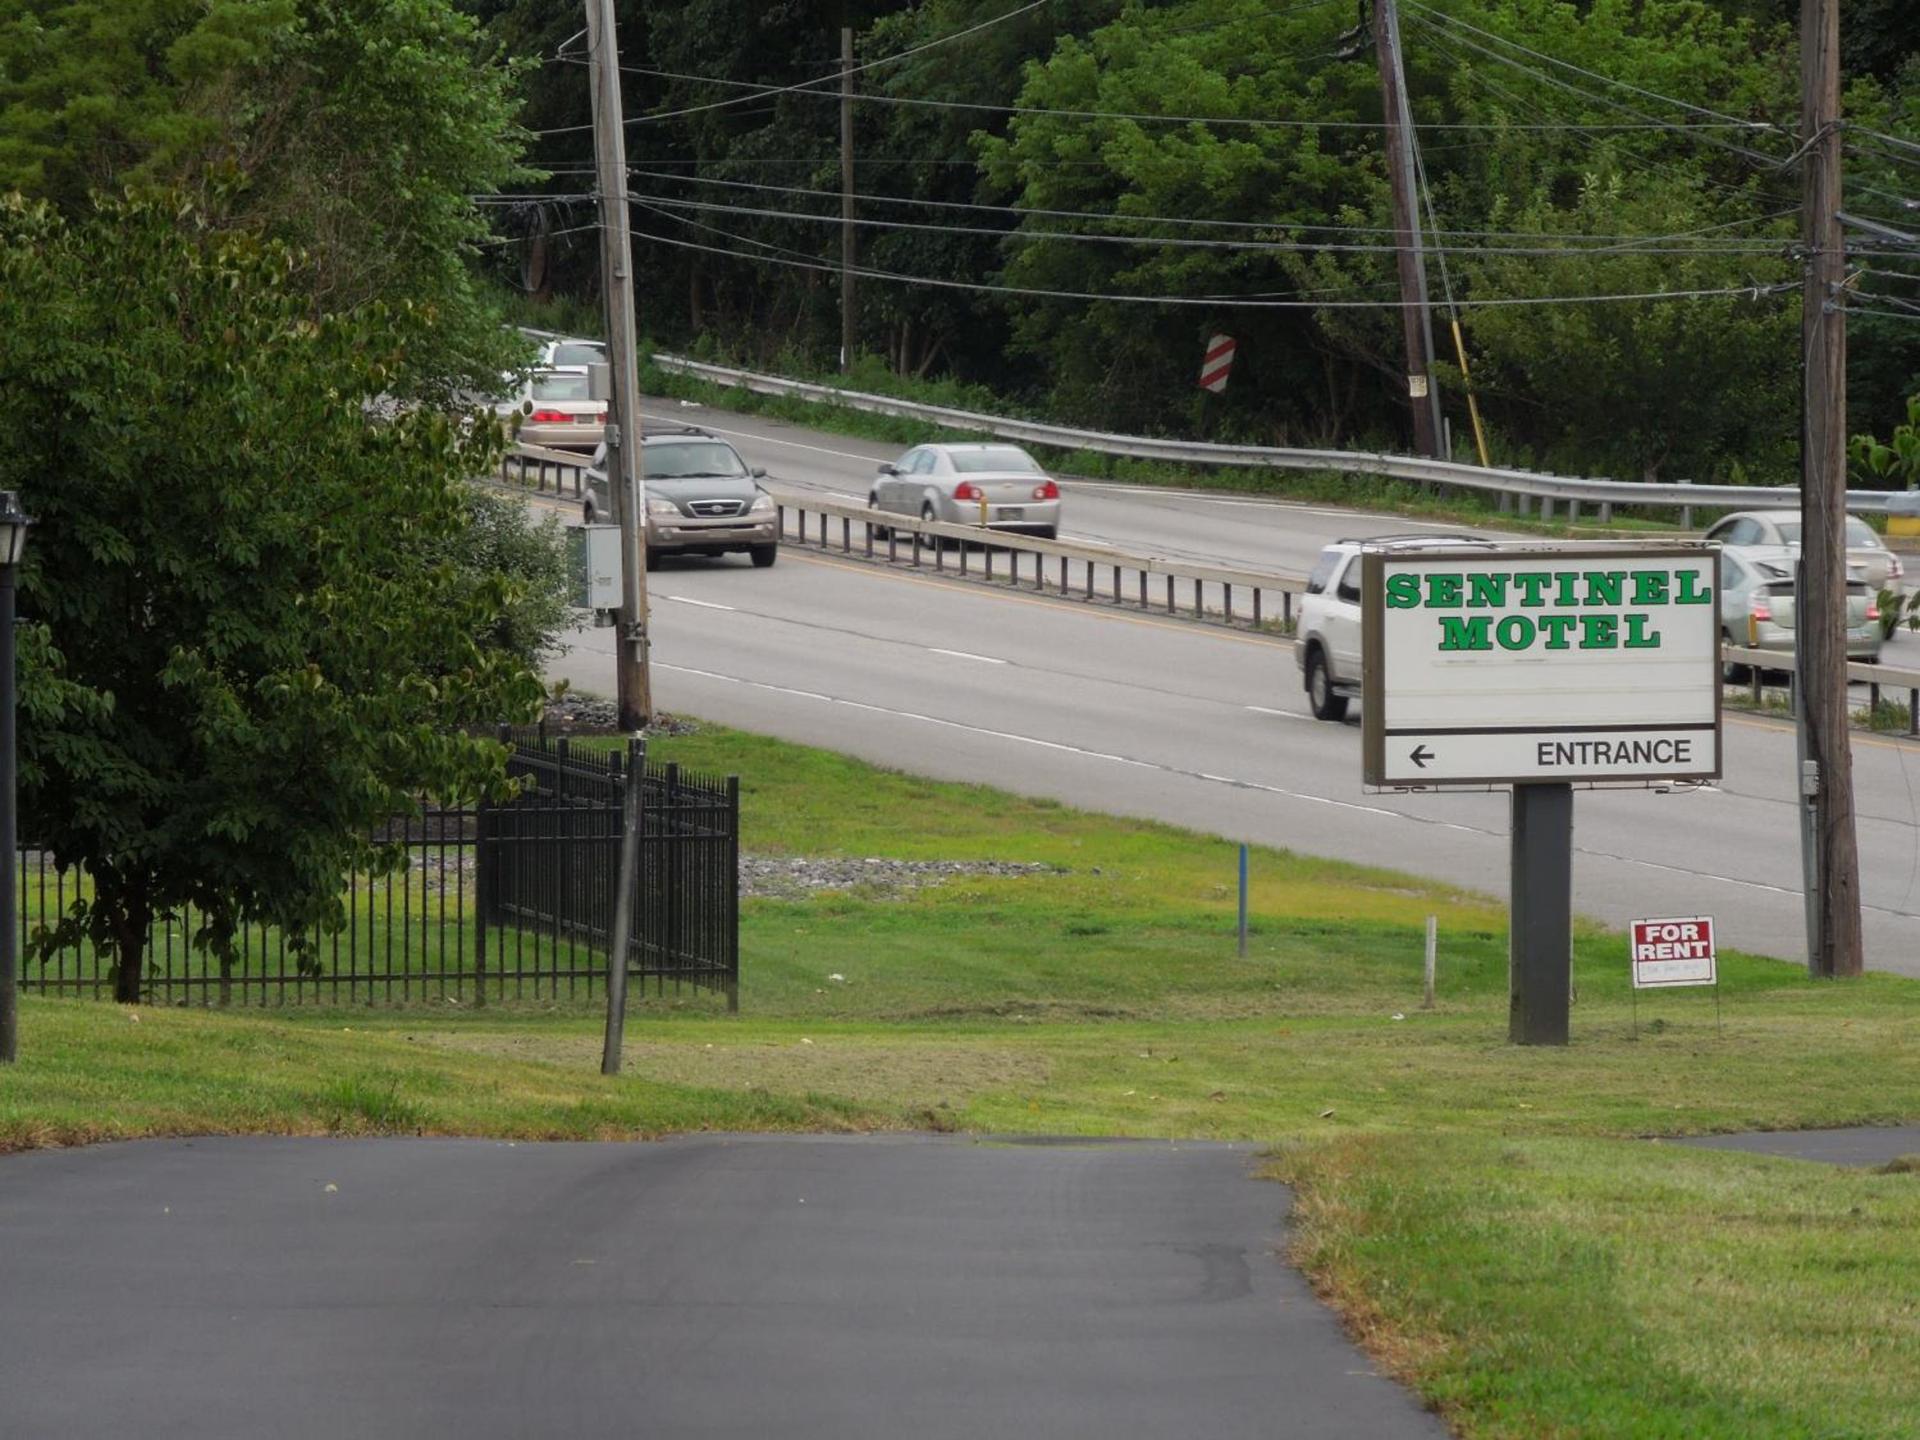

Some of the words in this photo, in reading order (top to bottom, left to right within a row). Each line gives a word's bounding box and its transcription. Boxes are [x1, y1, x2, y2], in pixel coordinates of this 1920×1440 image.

[1386, 571, 1711, 608] SENTINEL
[1439, 614, 1660, 650] MOTEL
[1537, 740, 1691, 765] ENTRANCE
[1645, 924, 1699, 942] FOR
[1638, 942, 1708, 960] RENT
